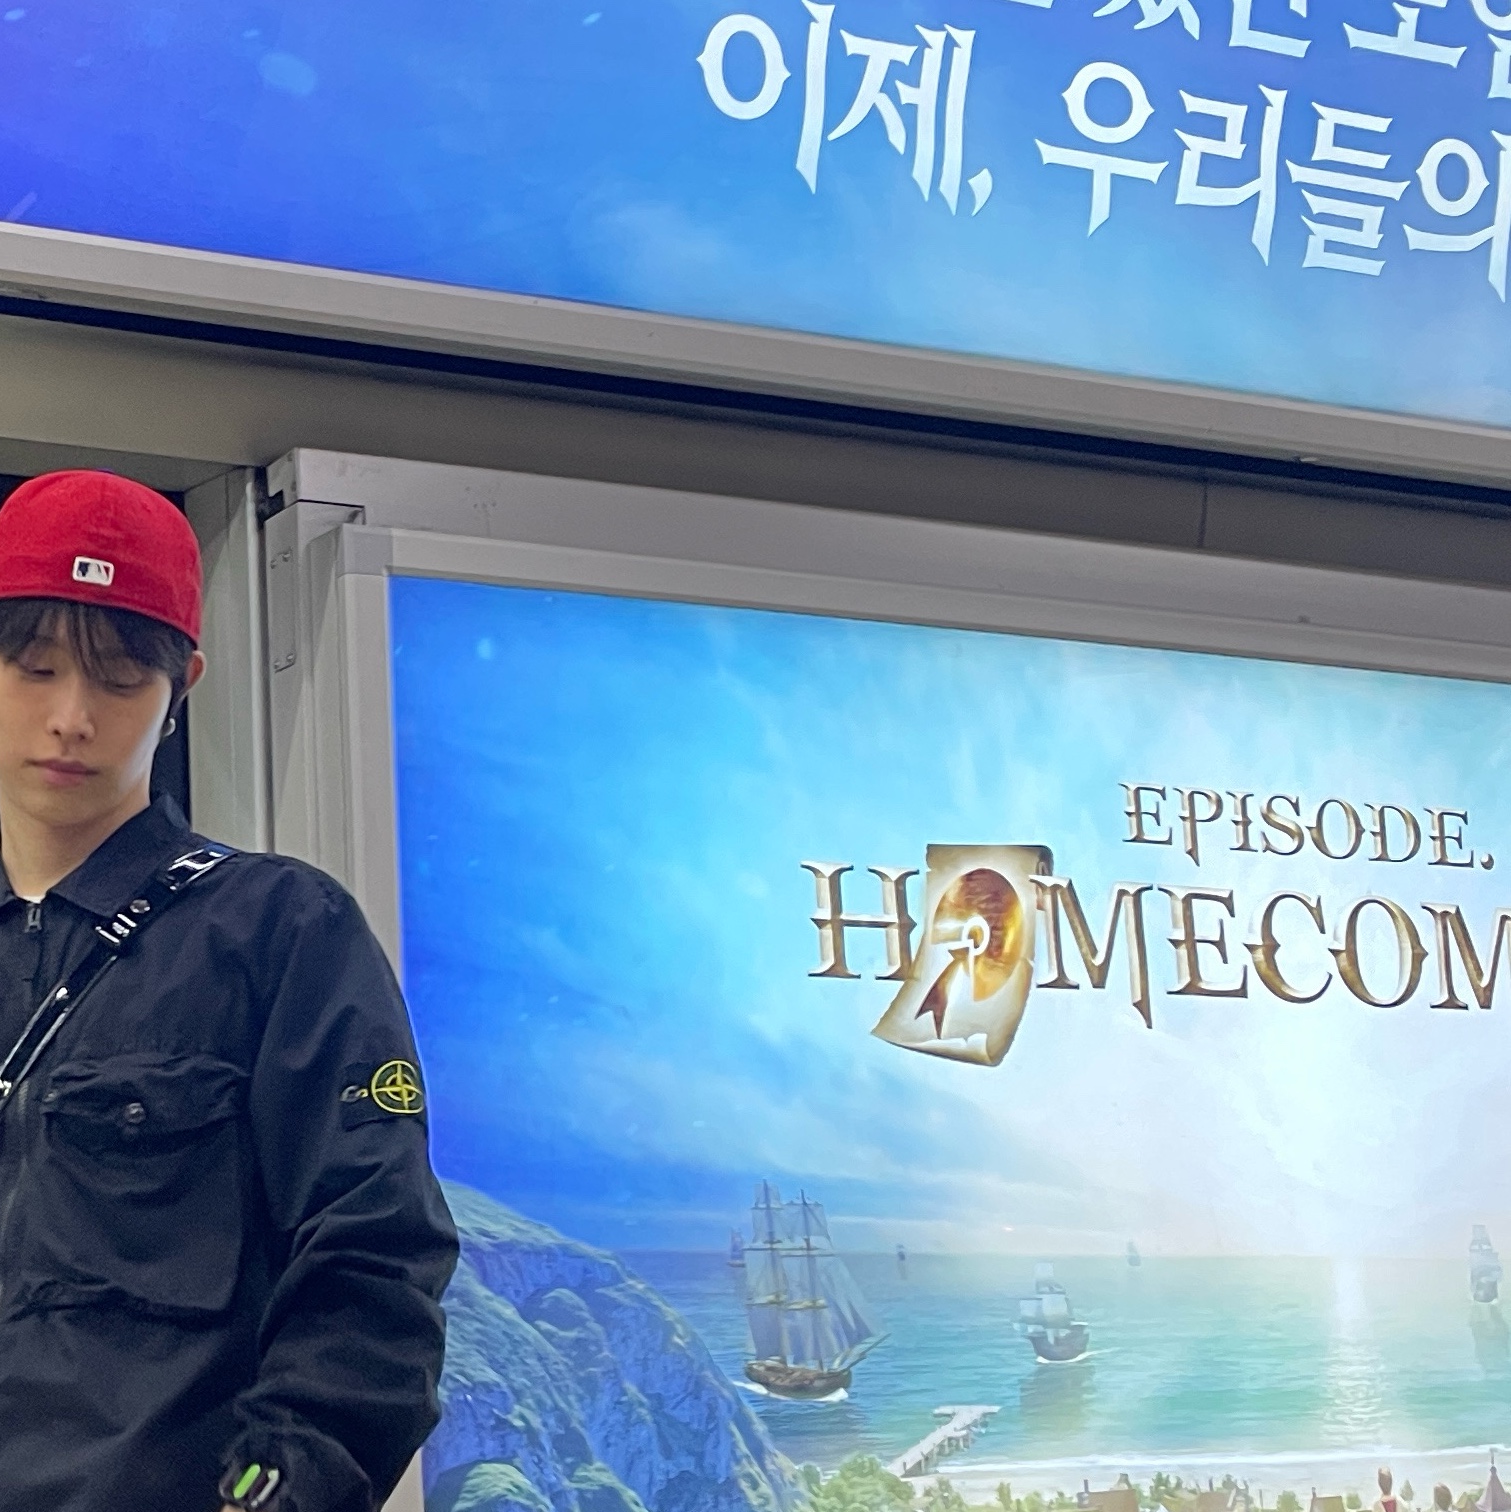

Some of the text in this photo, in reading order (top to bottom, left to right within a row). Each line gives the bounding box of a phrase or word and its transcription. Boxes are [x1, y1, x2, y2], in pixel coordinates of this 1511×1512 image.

[695, 0, 994, 217] 이제,
[1034, 60, 1511, 303] 우리들의
[1117, 781, 1495, 871] EPISODE.
